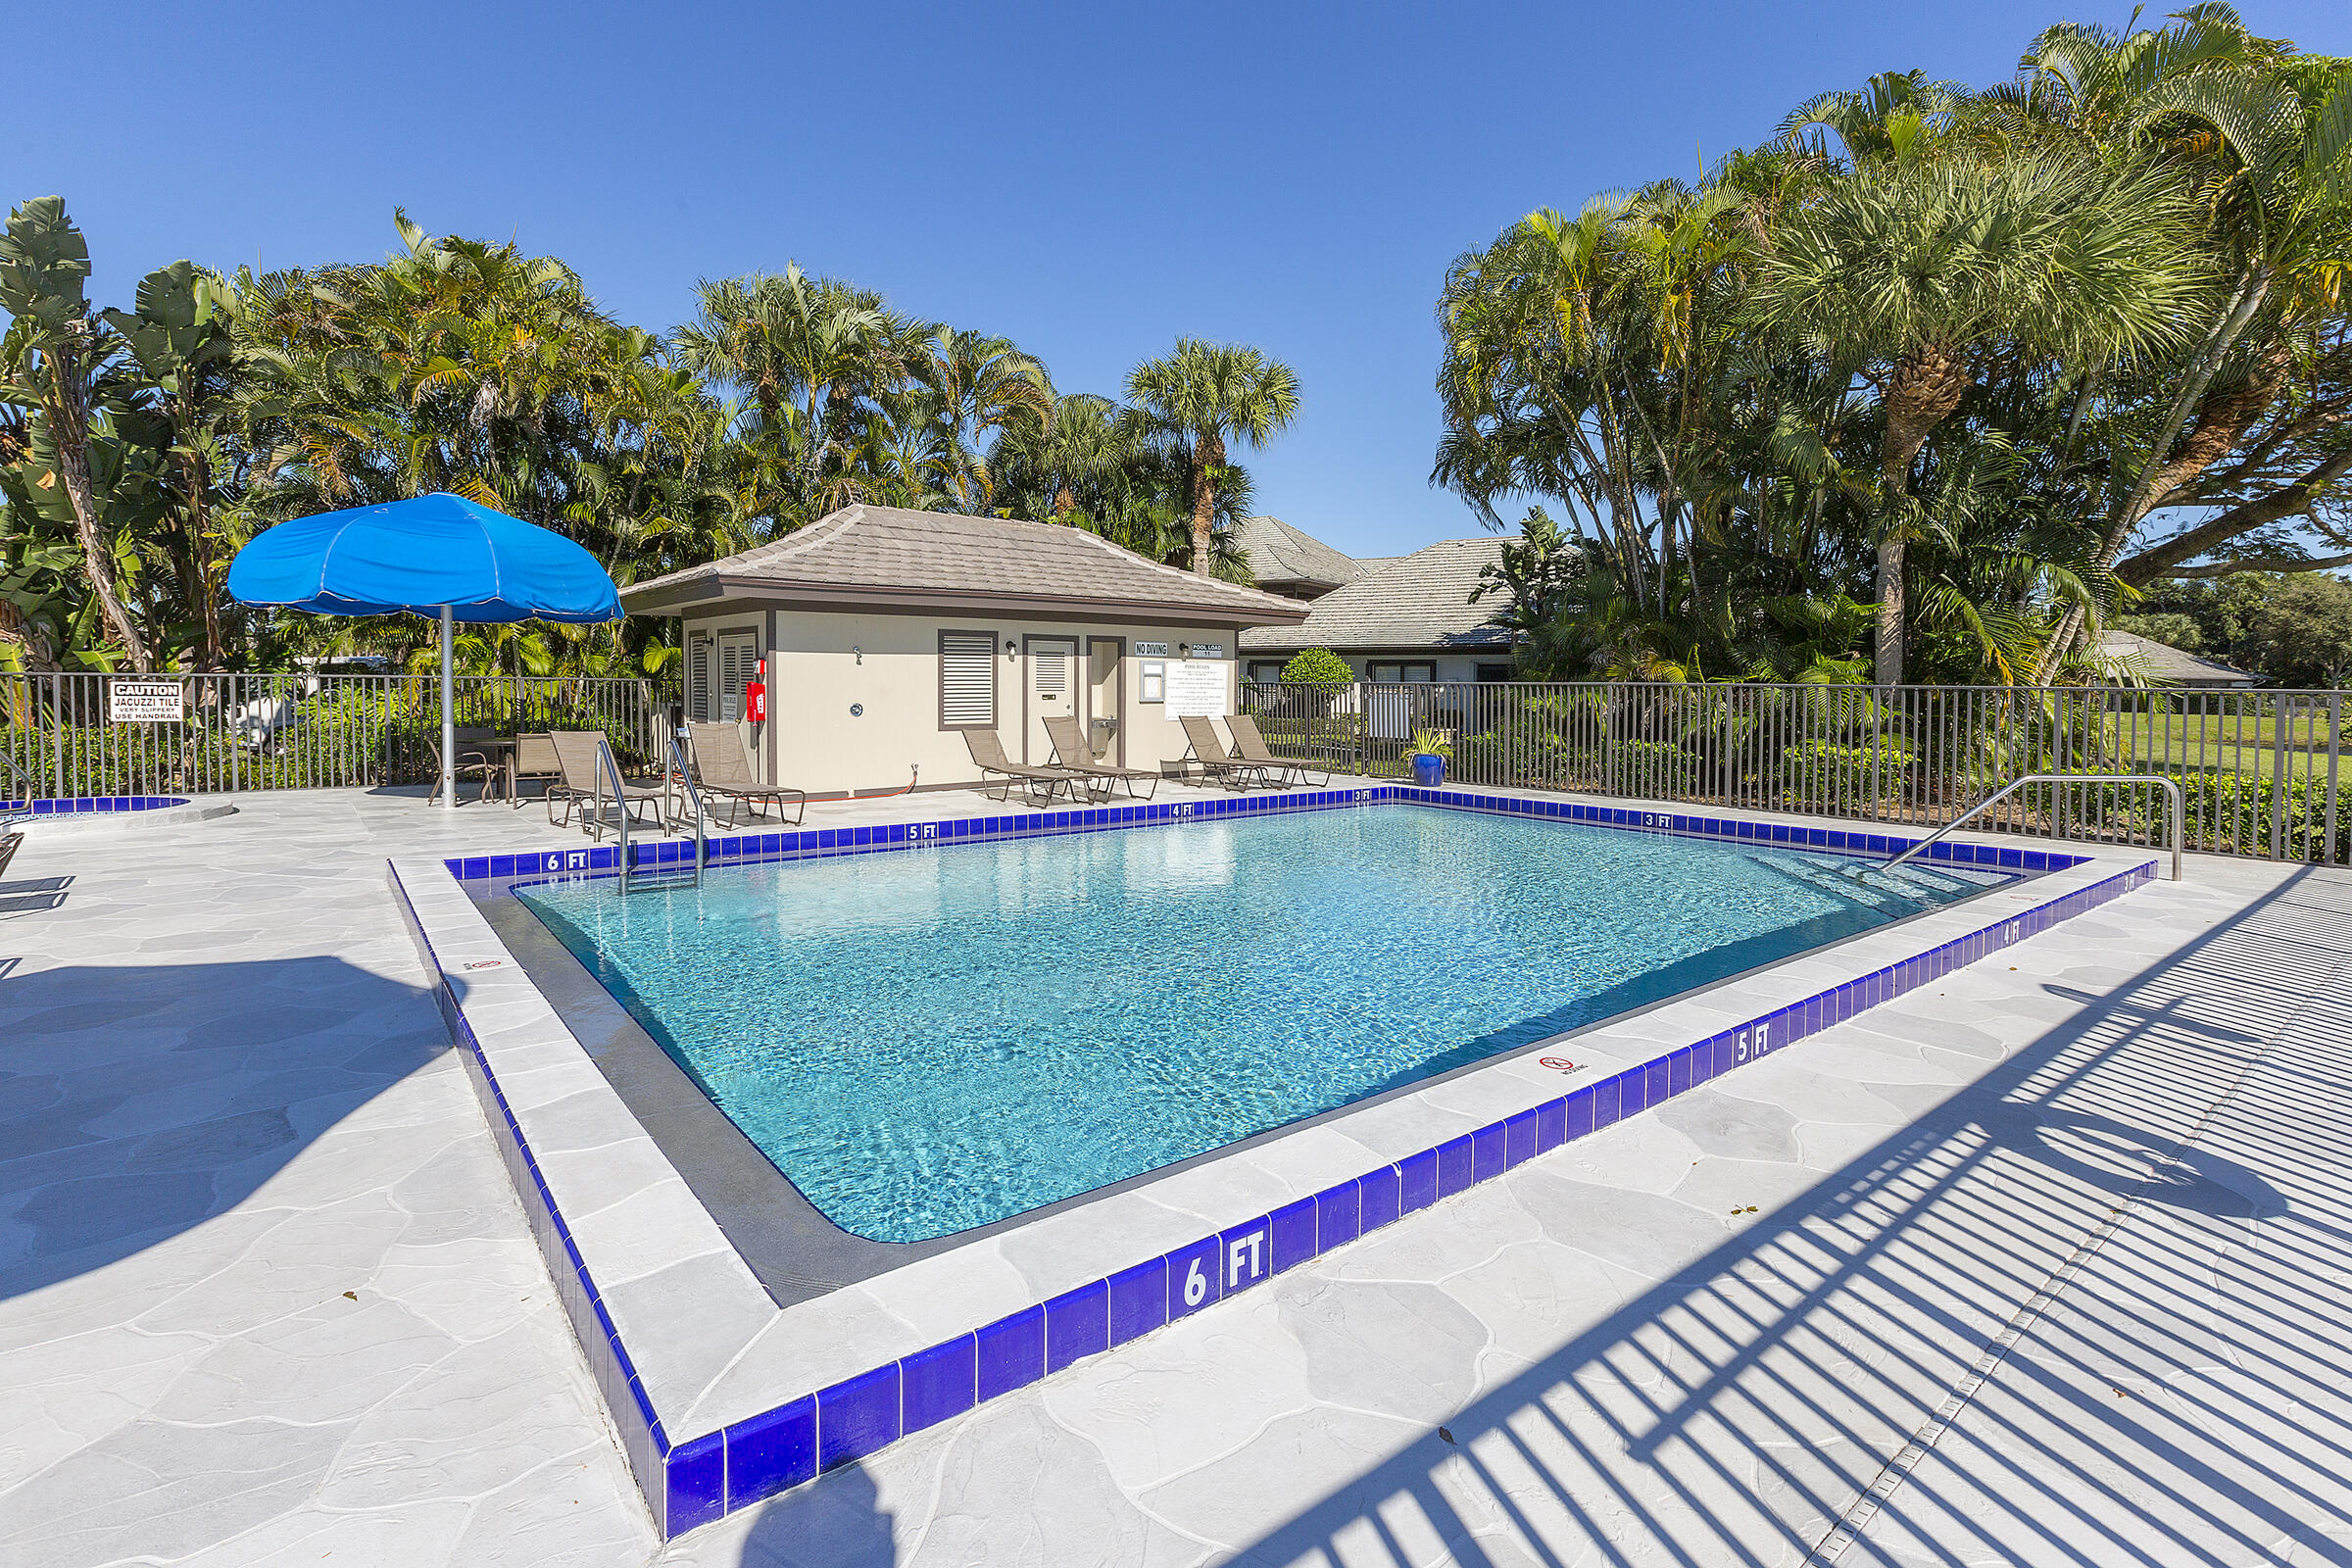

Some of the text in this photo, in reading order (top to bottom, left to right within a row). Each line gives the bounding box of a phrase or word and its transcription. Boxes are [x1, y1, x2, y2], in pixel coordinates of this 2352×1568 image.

[1137, 643, 1166, 655] NO DIVING
[116, 685, 178, 696] CAUTION
[1355, 791, 1360, 801] 3
[1173, 804, 1193, 816] 4 FT
[1645, 814, 1671, 828] 3 FT
[909, 825, 917, 839] 5
[547, 854, 559, 870] 6
[2004, 924, 2009, 945] 4
[1738, 1031, 1747, 1061] 5
[1184, 1256, 1206, 1307] 6
